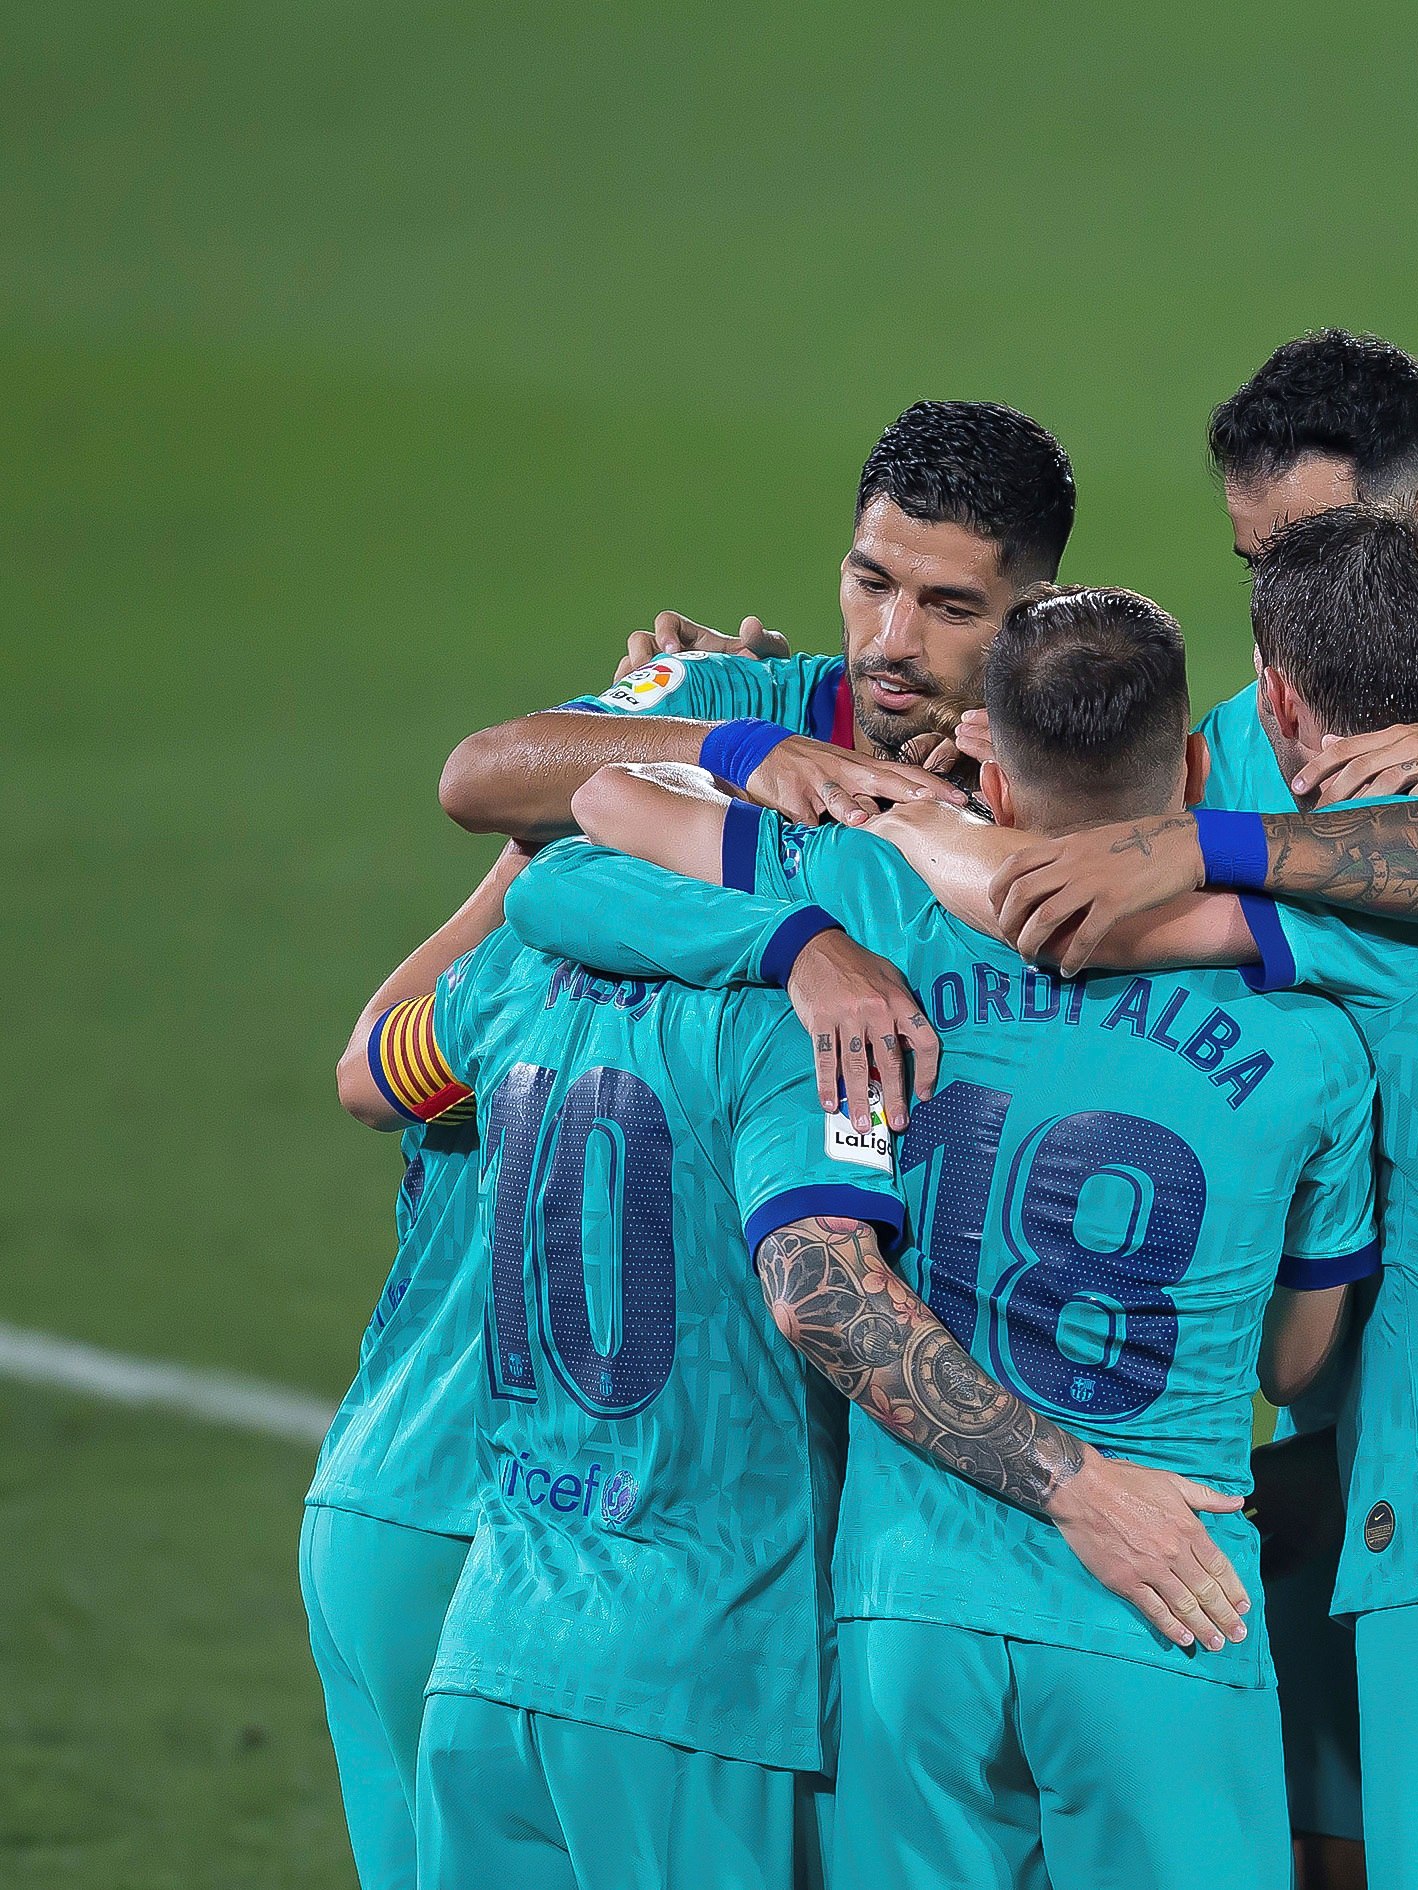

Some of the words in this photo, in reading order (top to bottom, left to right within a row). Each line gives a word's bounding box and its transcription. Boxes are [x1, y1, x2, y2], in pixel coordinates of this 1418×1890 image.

[916, 961, 1088, 1034] ORDI
[1099, 976, 1275, 1111] ALBA
[478, 1061, 677, 1421] 10
[900, 1079, 1208, 1425] 18
[499, 1451, 601, 1517] icef
